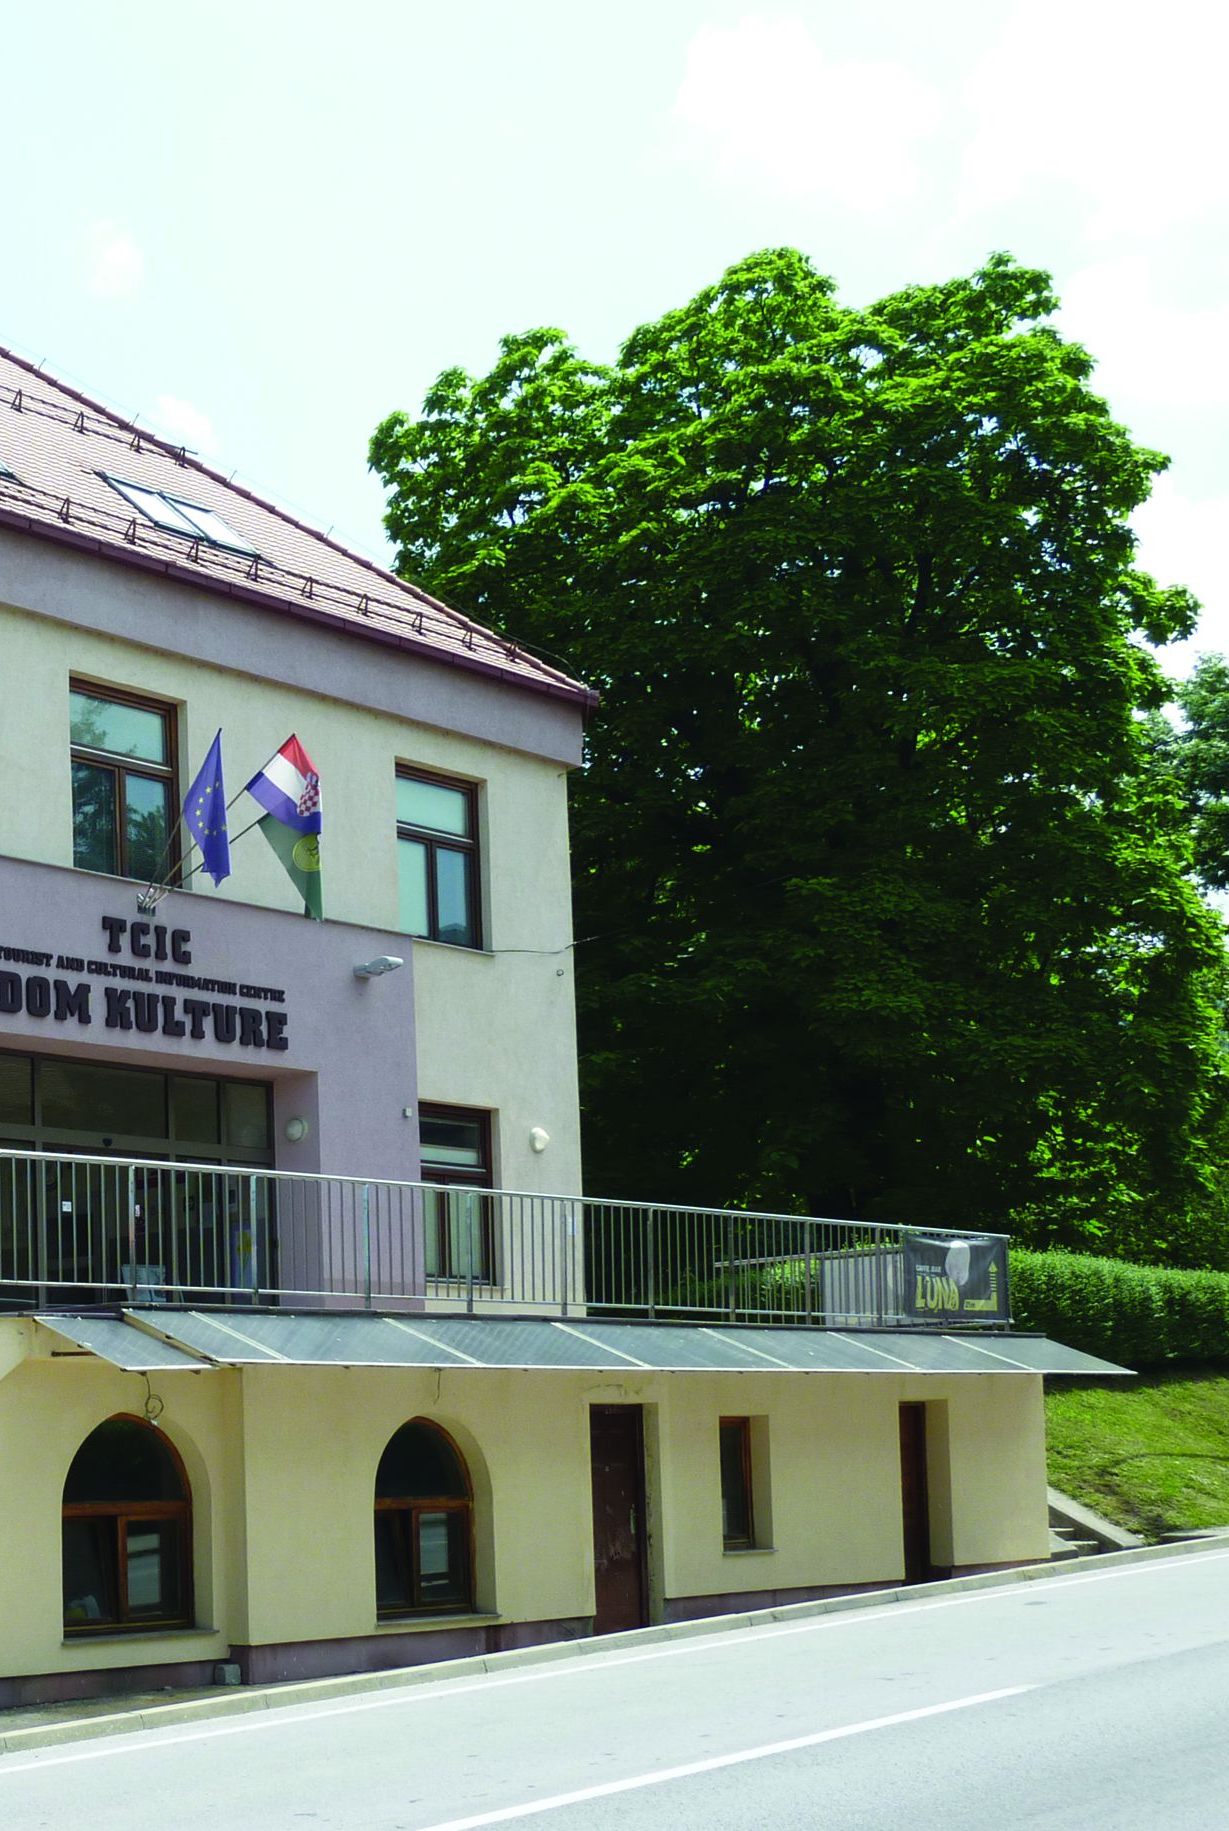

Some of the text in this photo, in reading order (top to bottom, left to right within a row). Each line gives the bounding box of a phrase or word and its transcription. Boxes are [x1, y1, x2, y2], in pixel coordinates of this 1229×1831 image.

[102, 915, 192, 964] TCIC
[56, 955, 85, 972] AND
[87, 960, 153, 983] CULTURAL
[155, 970, 237, 996] INFORMATION
[239, 983, 286, 1003] CENTRE
[104, 987, 289, 1051] KULTURE
[916, 1275, 959, 1310] LUNA
